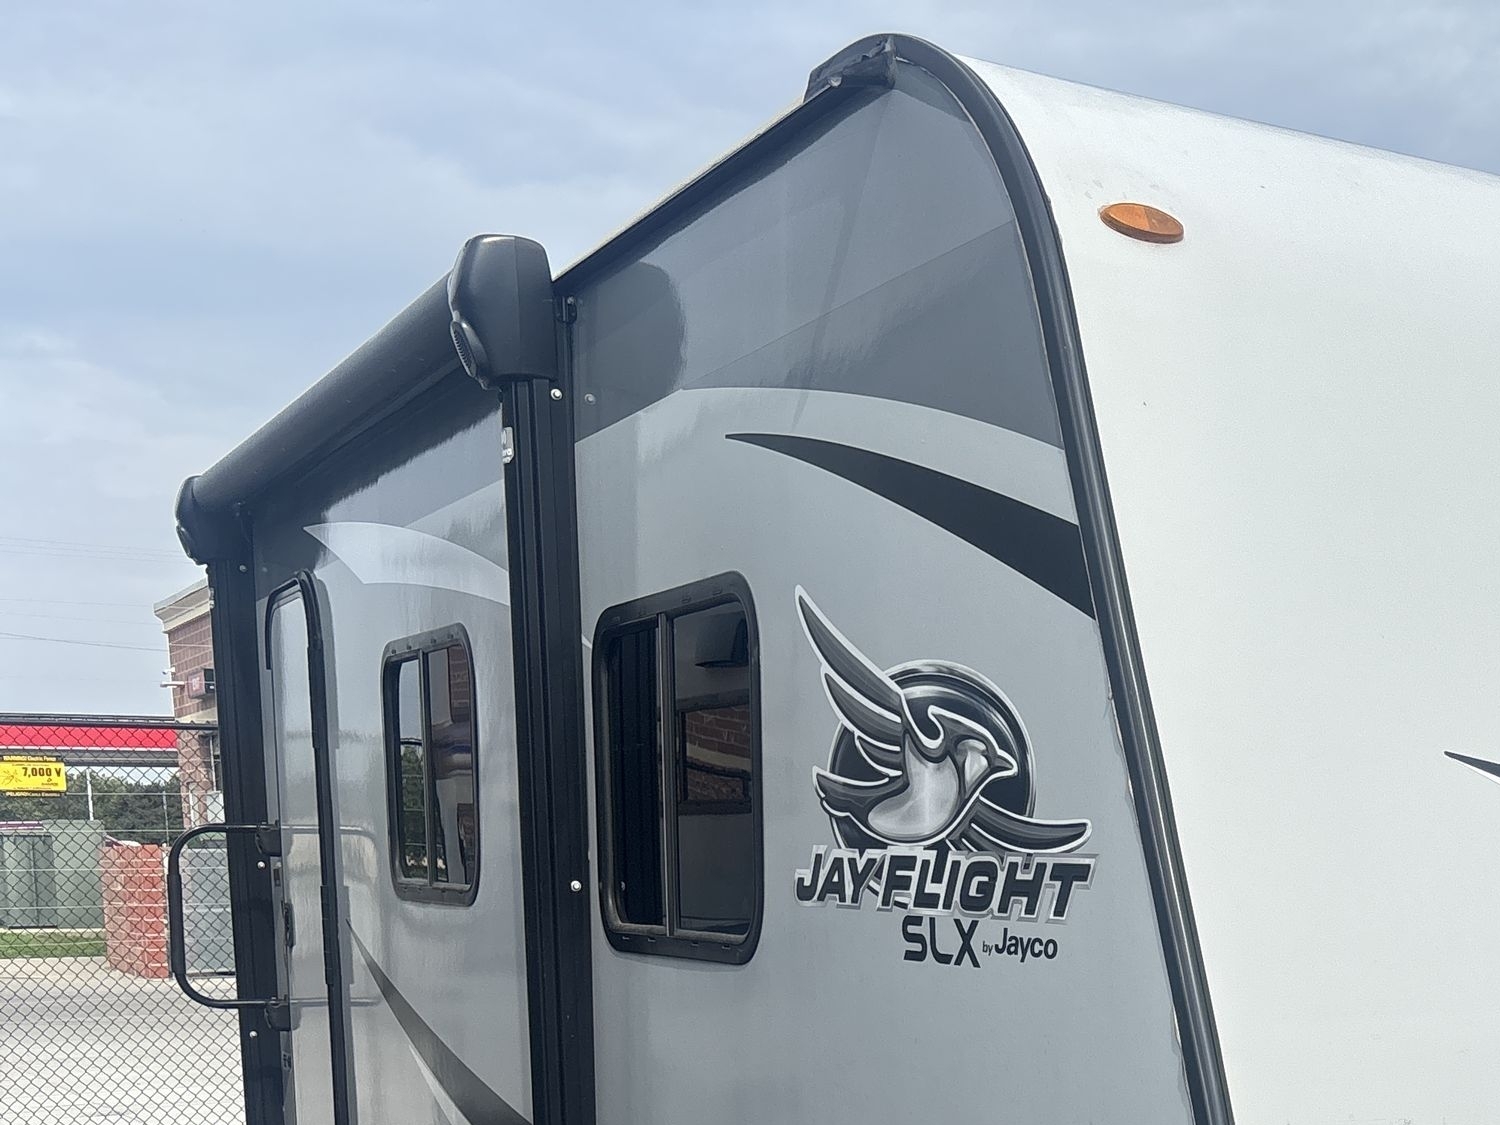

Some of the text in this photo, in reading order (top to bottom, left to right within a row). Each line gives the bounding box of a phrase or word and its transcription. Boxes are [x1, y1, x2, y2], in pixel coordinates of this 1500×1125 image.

[22, 767, 62, 778] 7,000 V
[879, 849, 1097, 923] FLIGHT
[902, 914, 1059, 968] SLX by Jayco
